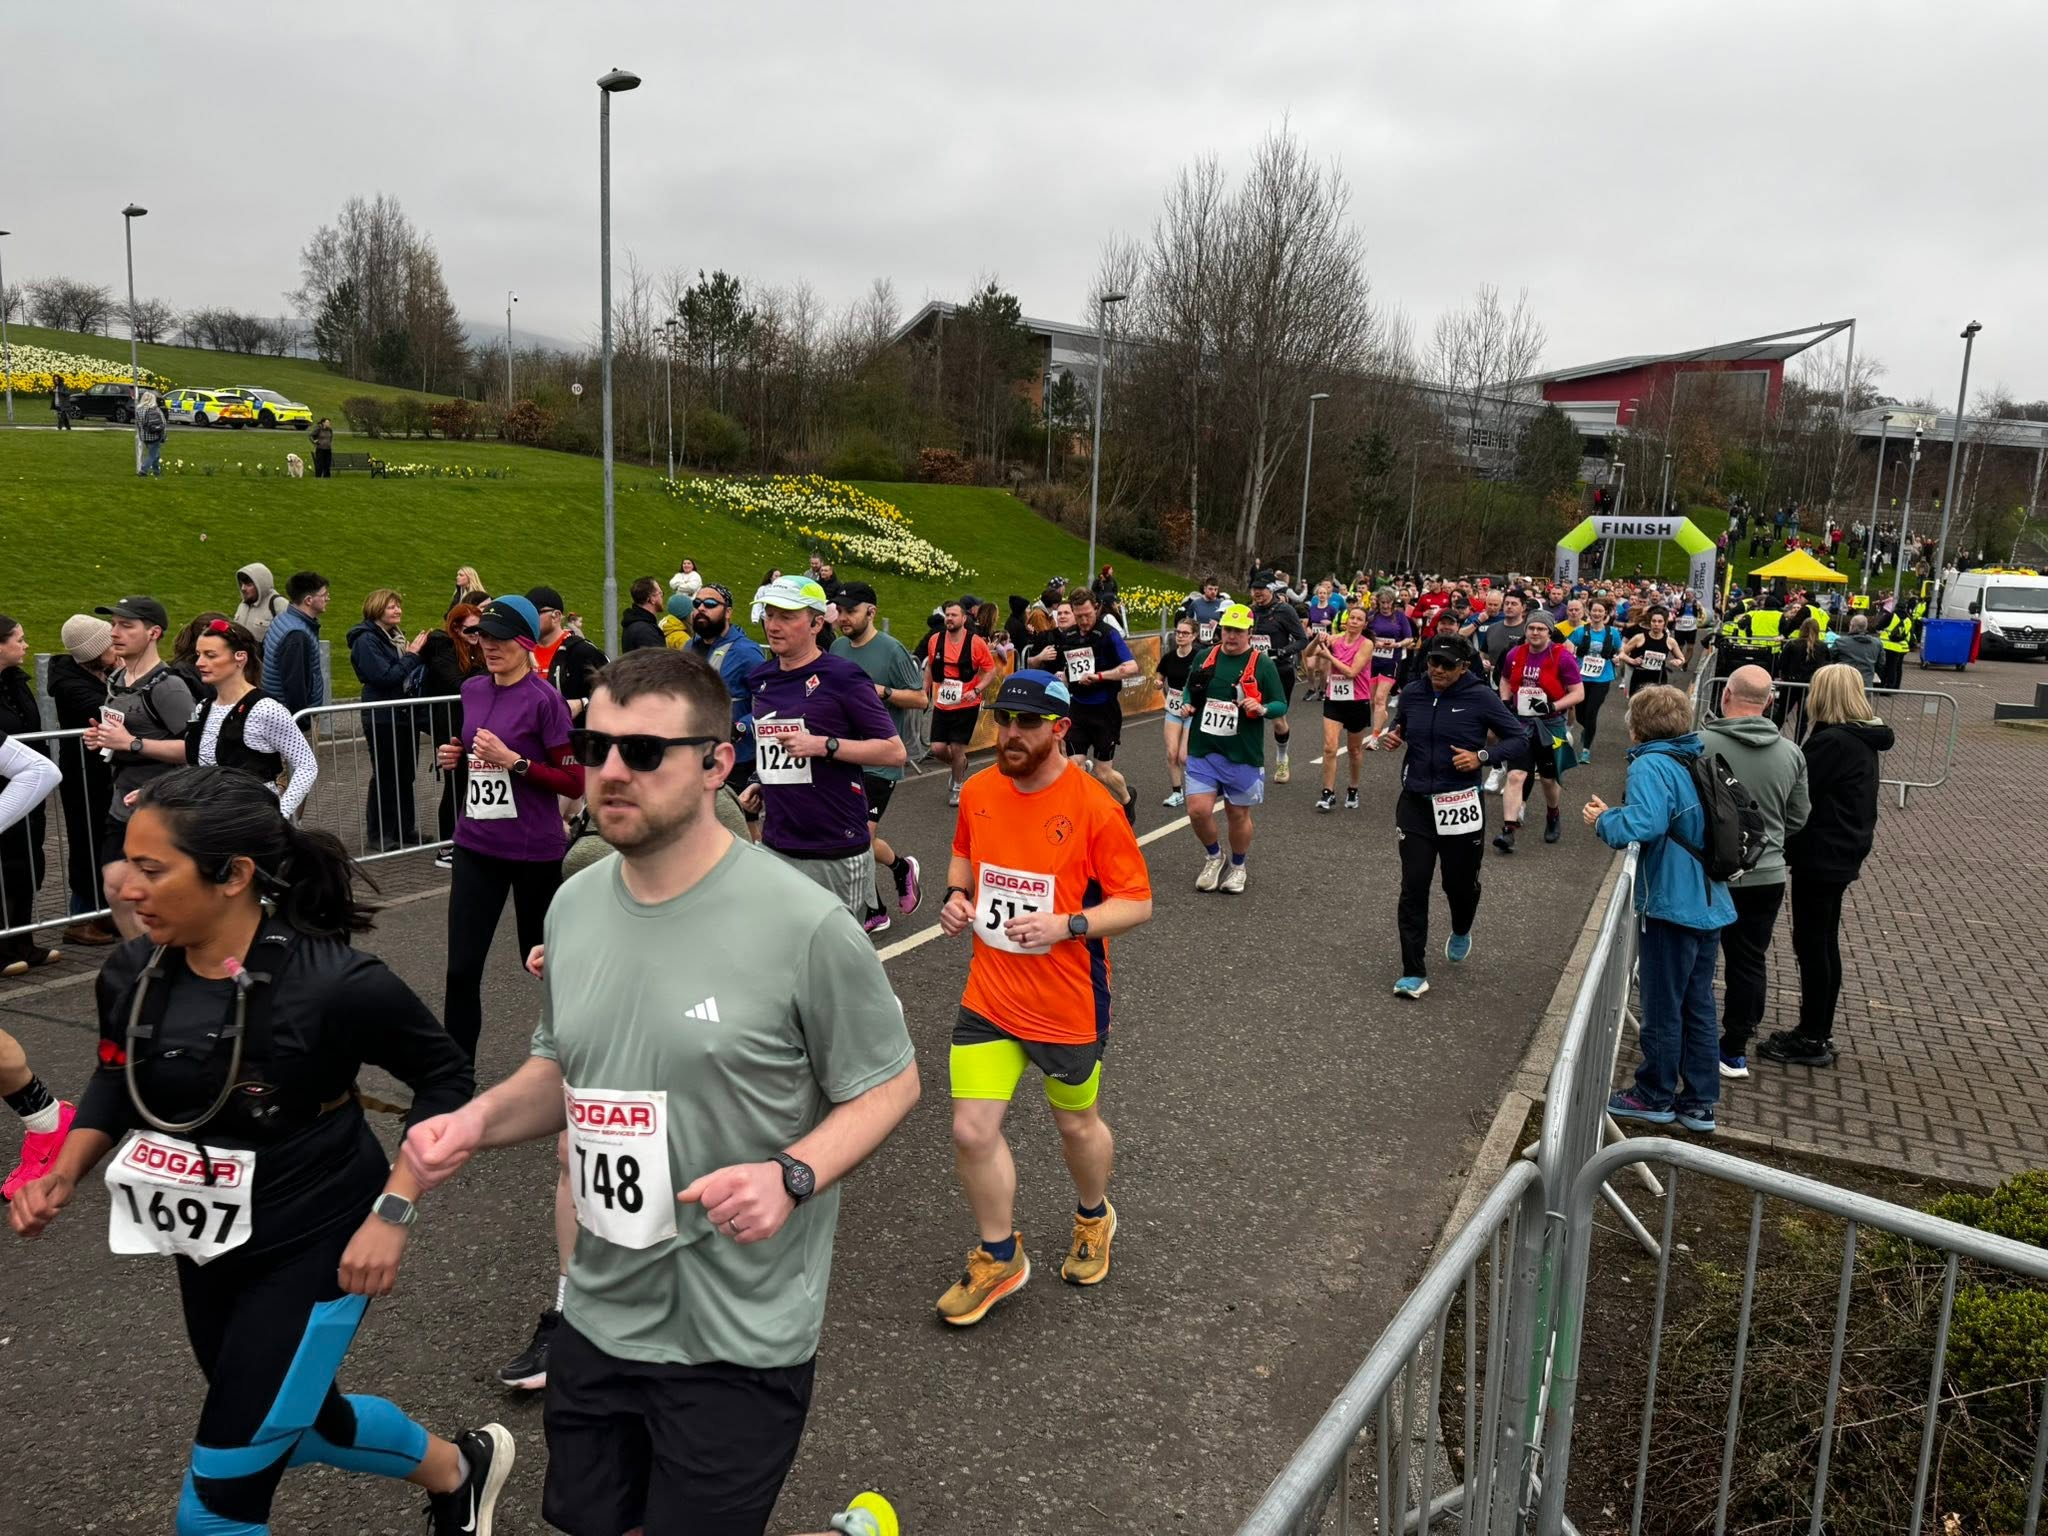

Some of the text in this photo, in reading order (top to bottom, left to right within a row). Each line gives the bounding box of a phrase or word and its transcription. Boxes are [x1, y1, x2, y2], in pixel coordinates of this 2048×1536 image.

[1601, 522, 1671, 535] FINISH
[1070, 659, 1090, 674] 553
[941, 689, 957, 701] 466
[1204, 711, 1235, 730] 2174
[1437, 791, 1474, 803] GOGAR
[1438, 805, 1480, 826] 2288
[985, 872, 1046, 894] GOGAR
[132, 1143, 236, 1182] GOGAR
[119, 1183, 241, 1244] 1697
